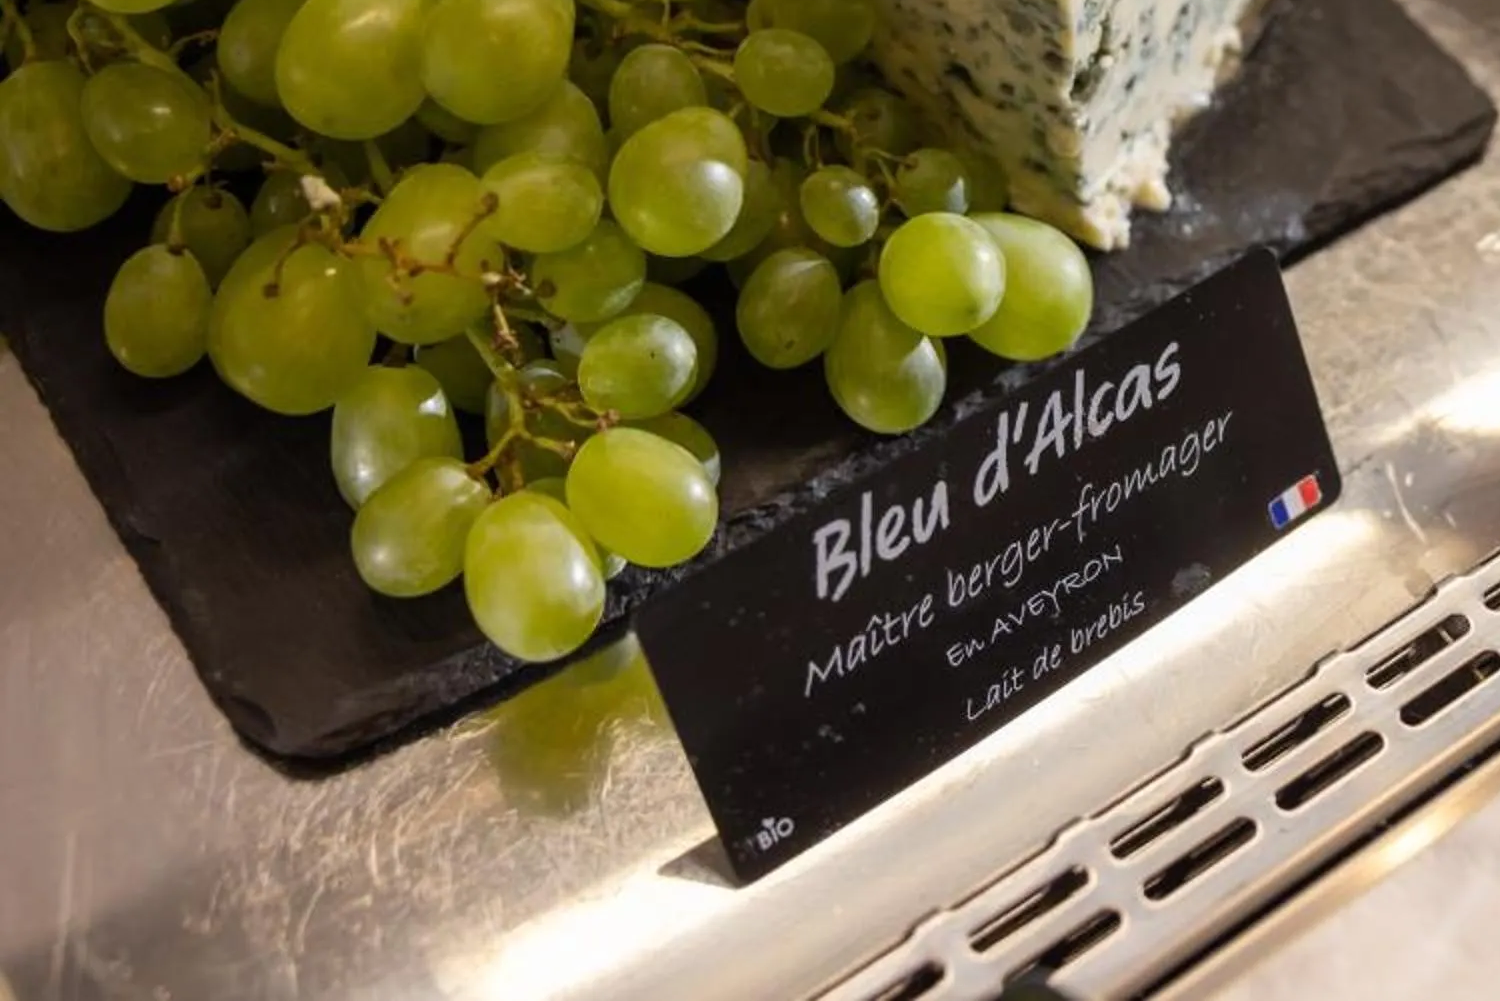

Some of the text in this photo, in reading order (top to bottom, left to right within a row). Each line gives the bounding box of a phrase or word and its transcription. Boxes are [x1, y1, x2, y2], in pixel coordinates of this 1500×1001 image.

[804, 410, 1234, 696] Maître berger-fromager
[813, 341, 1181, 601] Bleu d'Alcas
[946, 545, 1124, 668] En AVEYRON
[966, 592, 1145, 721] Lait de brebis
